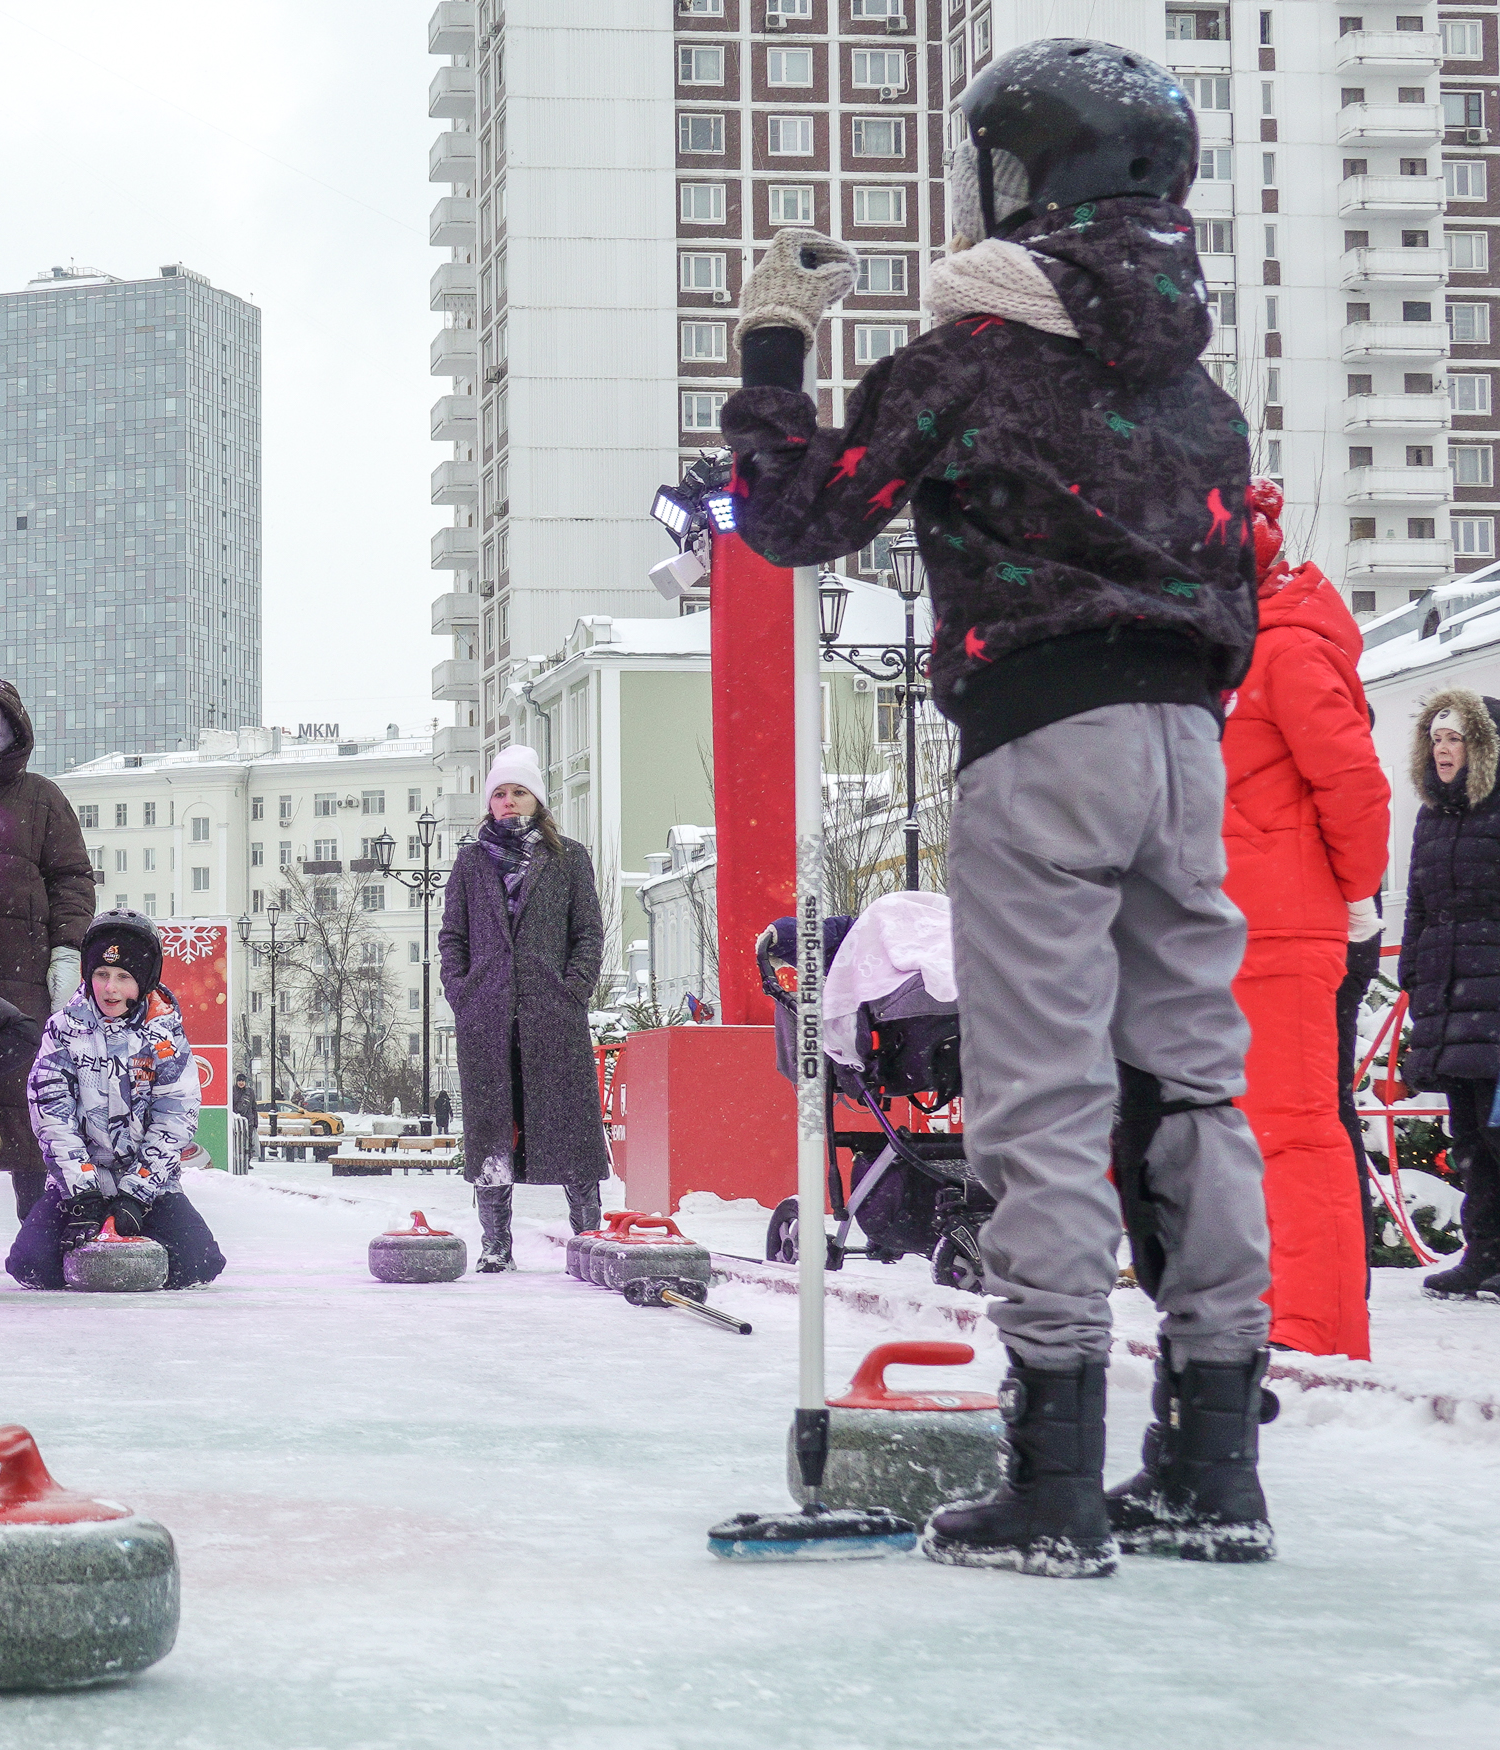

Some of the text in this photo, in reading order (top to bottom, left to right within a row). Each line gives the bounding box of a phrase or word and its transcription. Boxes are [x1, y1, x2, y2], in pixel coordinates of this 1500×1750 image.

[299, 723, 339, 739] МКМ
[801, 895, 821, 1079] Olson Fiberglass
